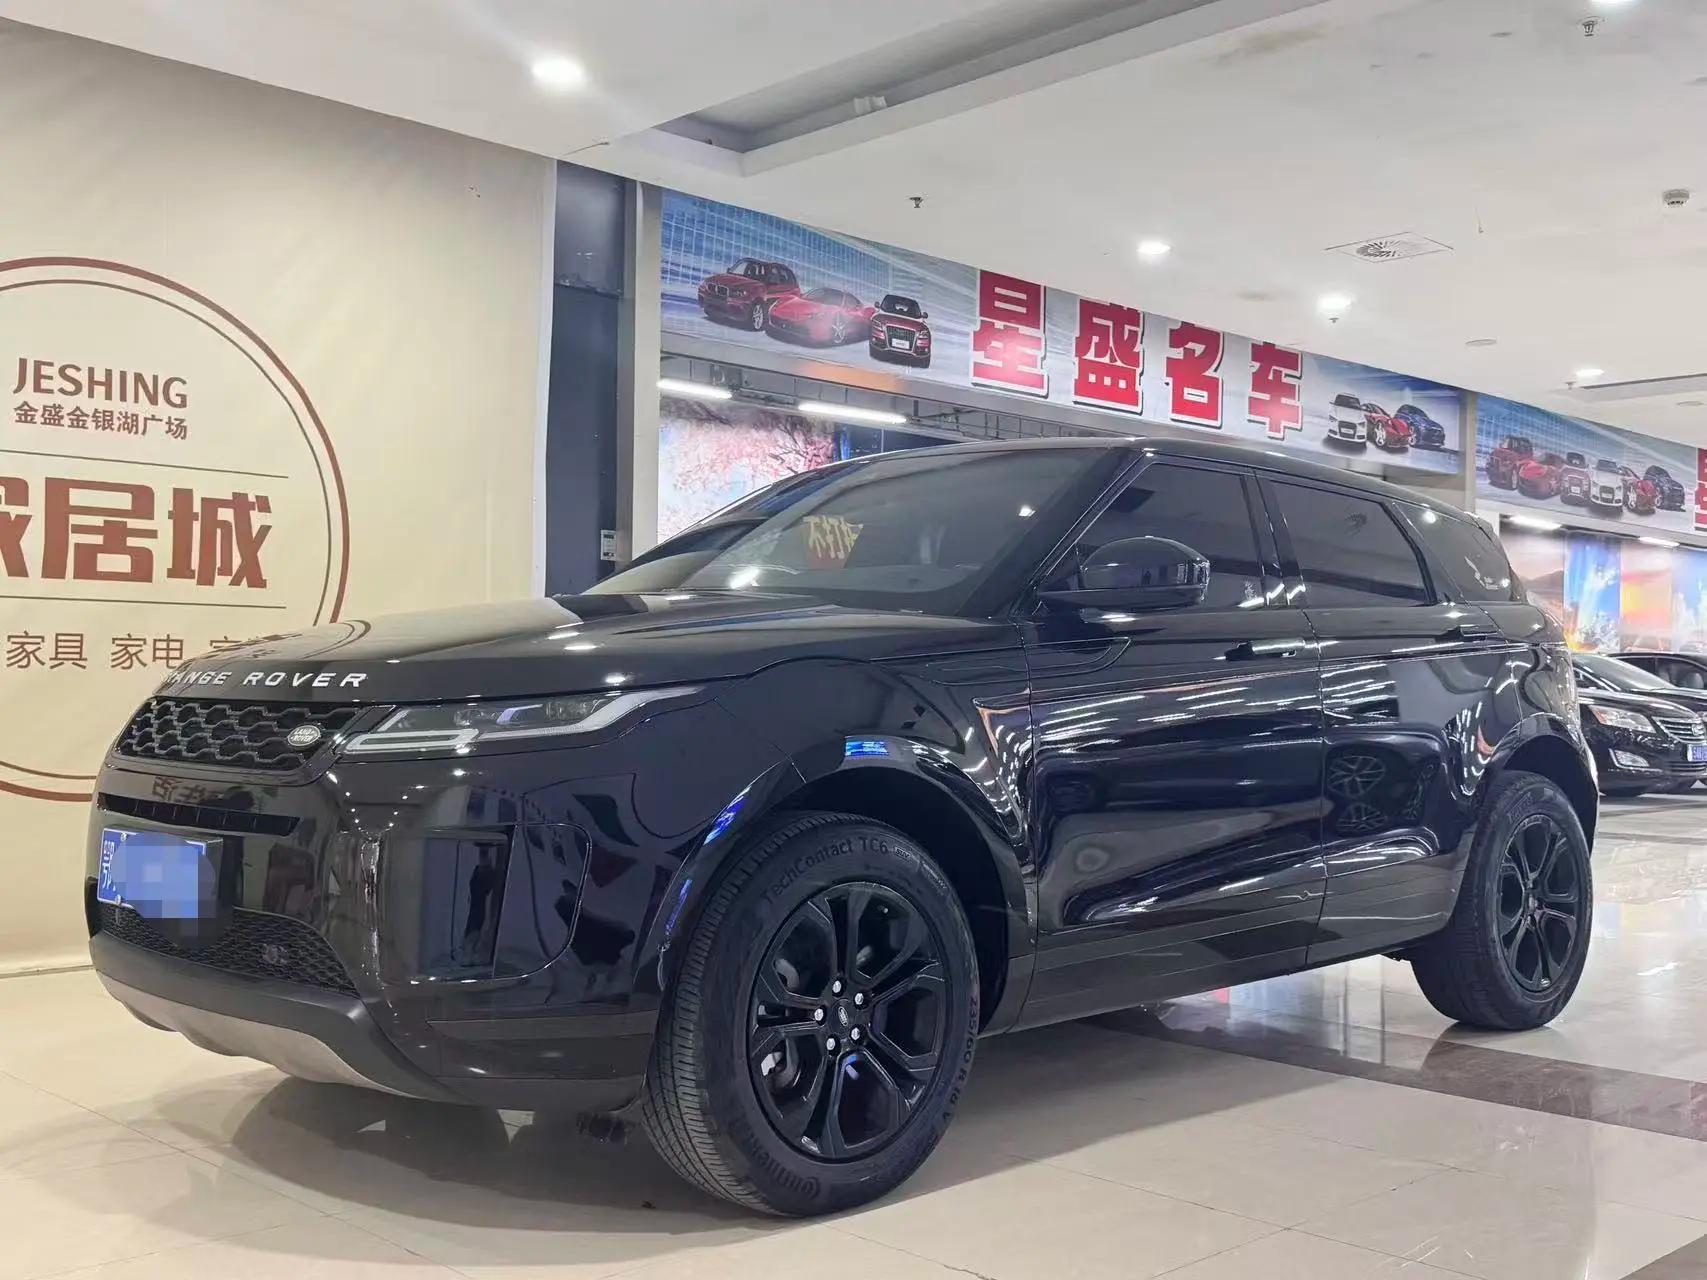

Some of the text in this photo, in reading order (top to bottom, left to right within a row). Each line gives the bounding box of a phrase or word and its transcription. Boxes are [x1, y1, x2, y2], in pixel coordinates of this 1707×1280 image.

[971, 268, 1302, 440] 星盛名车
[13, 357, 188, 410] JESHING
[13, 400, 188, 440] 金盛金银湖广场
[6, 631, 87, 670] 家具
[110, 633, 184, 670] 家电
[167, 671, 367, 687] ANGE ROVER
[858, 836, 888, 854] TC6
